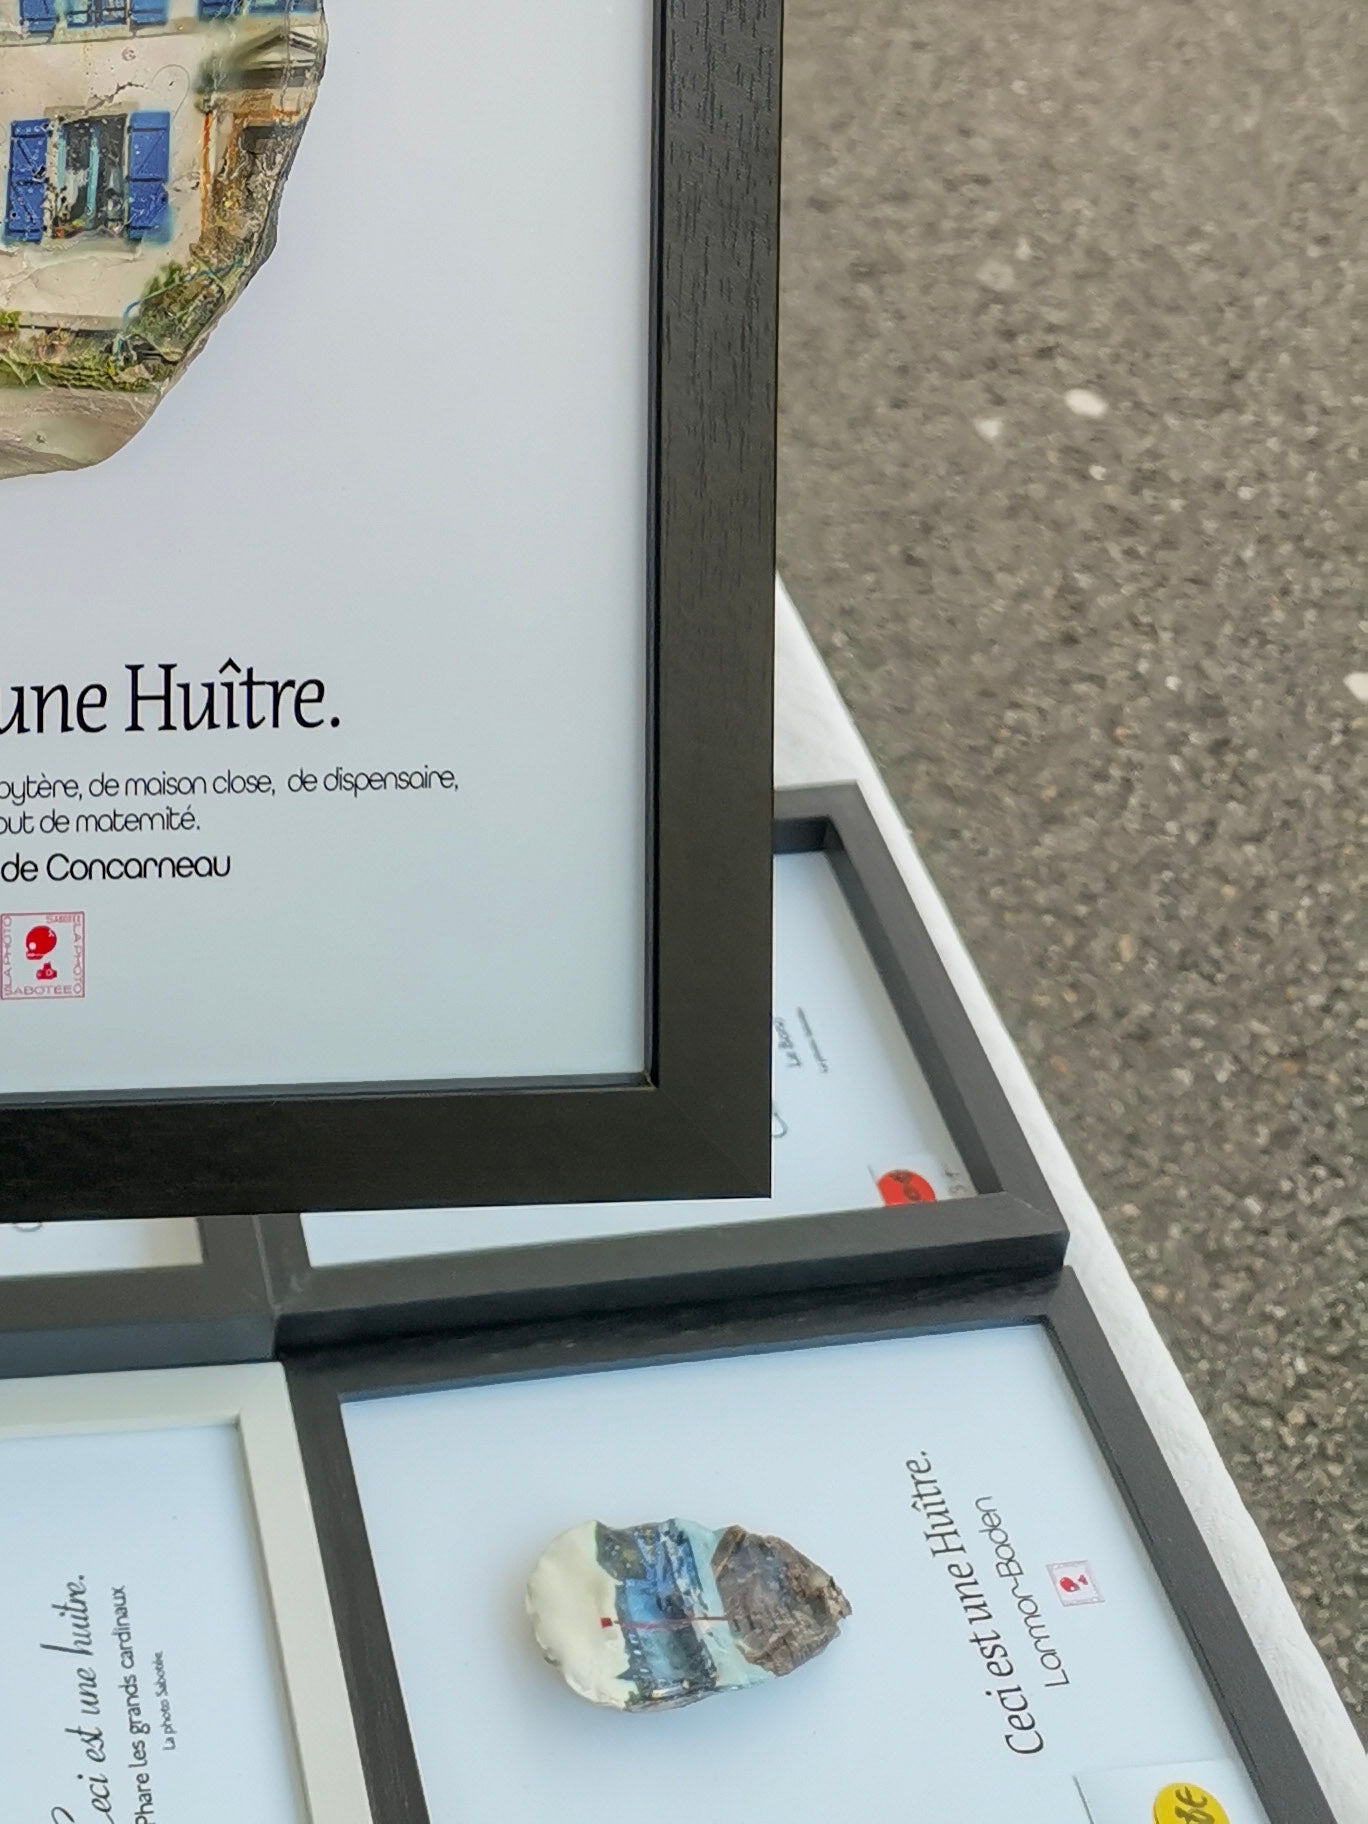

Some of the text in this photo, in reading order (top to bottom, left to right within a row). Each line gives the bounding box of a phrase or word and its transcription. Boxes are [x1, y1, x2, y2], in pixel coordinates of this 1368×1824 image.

[124, 656, 342, 734] Huître.
[88, 771, 120, 798] de
[125, 769, 208, 798] maison
[212, 768, 277, 796] close,
[287, 767, 319, 793] de
[322, 763, 460, 798] dispensaire,
[39, 807, 71, 834] de
[0, 851, 40, 883] de
[45, 852, 232, 882] Concarneau
[904, 1449, 1045, 1756] Ceci est une Huître.
[973, 1495, 1071, 1688] Larmor-Baden
[76, 1666, 101, 1716] une
[110, 1584, 156, 1824] Phare les grands cardinaux
[159, 1698, 178, 1735] photo
[64, 1725, 107, 1763] est
[162, 1736, 177, 1751] La
